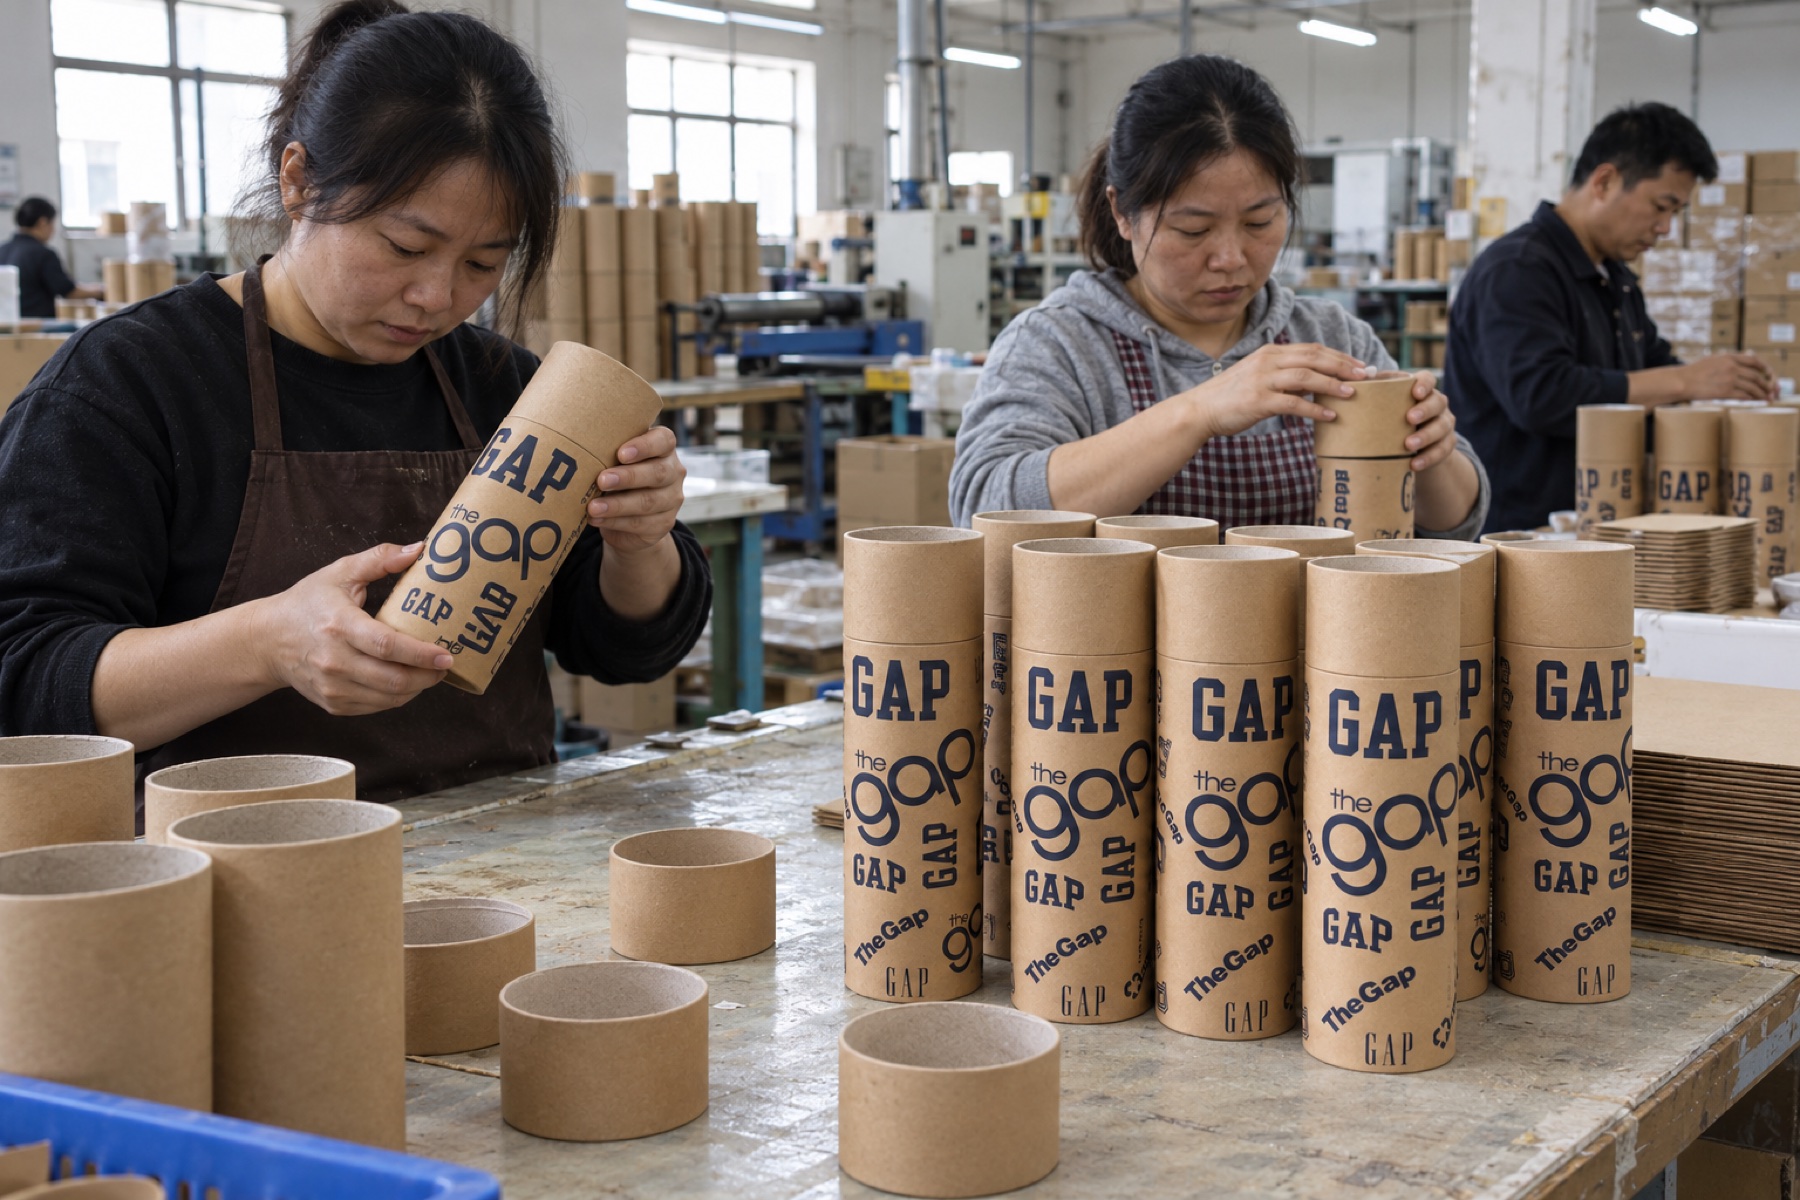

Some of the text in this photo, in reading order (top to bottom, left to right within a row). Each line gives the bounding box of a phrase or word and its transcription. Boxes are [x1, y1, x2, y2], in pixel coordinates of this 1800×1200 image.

[471, 427, 578, 504] GAP
[1659, 470, 1710, 501] GAP
[450, 503, 480, 524] the
[425, 518, 562, 583] gap
[401, 588, 453, 626] GAP
[853, 655, 949, 721] GAP
[1028, 666, 1132, 734] GAP
[1192, 675, 1293, 742] GAP
[1536, 659, 1629, 721] GAP
[1329, 688, 1442, 759] GAP
[855, 749, 886, 771] the
[1031, 762, 1067, 785] the
[1193, 770, 1236, 792] the
[1537, 751, 1579, 771] the
[851, 728, 975, 846] gap
[1024, 739, 1151, 861] gap
[1322, 762, 1458, 897] the gap
[854, 853, 906, 894] GAP
[922, 823, 957, 890] GAP
[1101, 836, 1136, 904] GAP
[1268, 840, 1294, 911] GAP
[1534, 859, 1598, 895] GAP
[1608, 821, 1629, 890] GAP
[1025, 869, 1084, 911] GAP
[1187, 880, 1254, 920] GAP
[1410, 865, 1445, 942] GAP
[1323, 908, 1392, 954] GAP
[885, 966, 928, 998] GAP
[1062, 985, 1105, 1017] GAP
[1577, 964, 1615, 996] GAP
[1225, 1000, 1269, 1033] GAP
[1365, 1032, 1413, 1066] GAP
